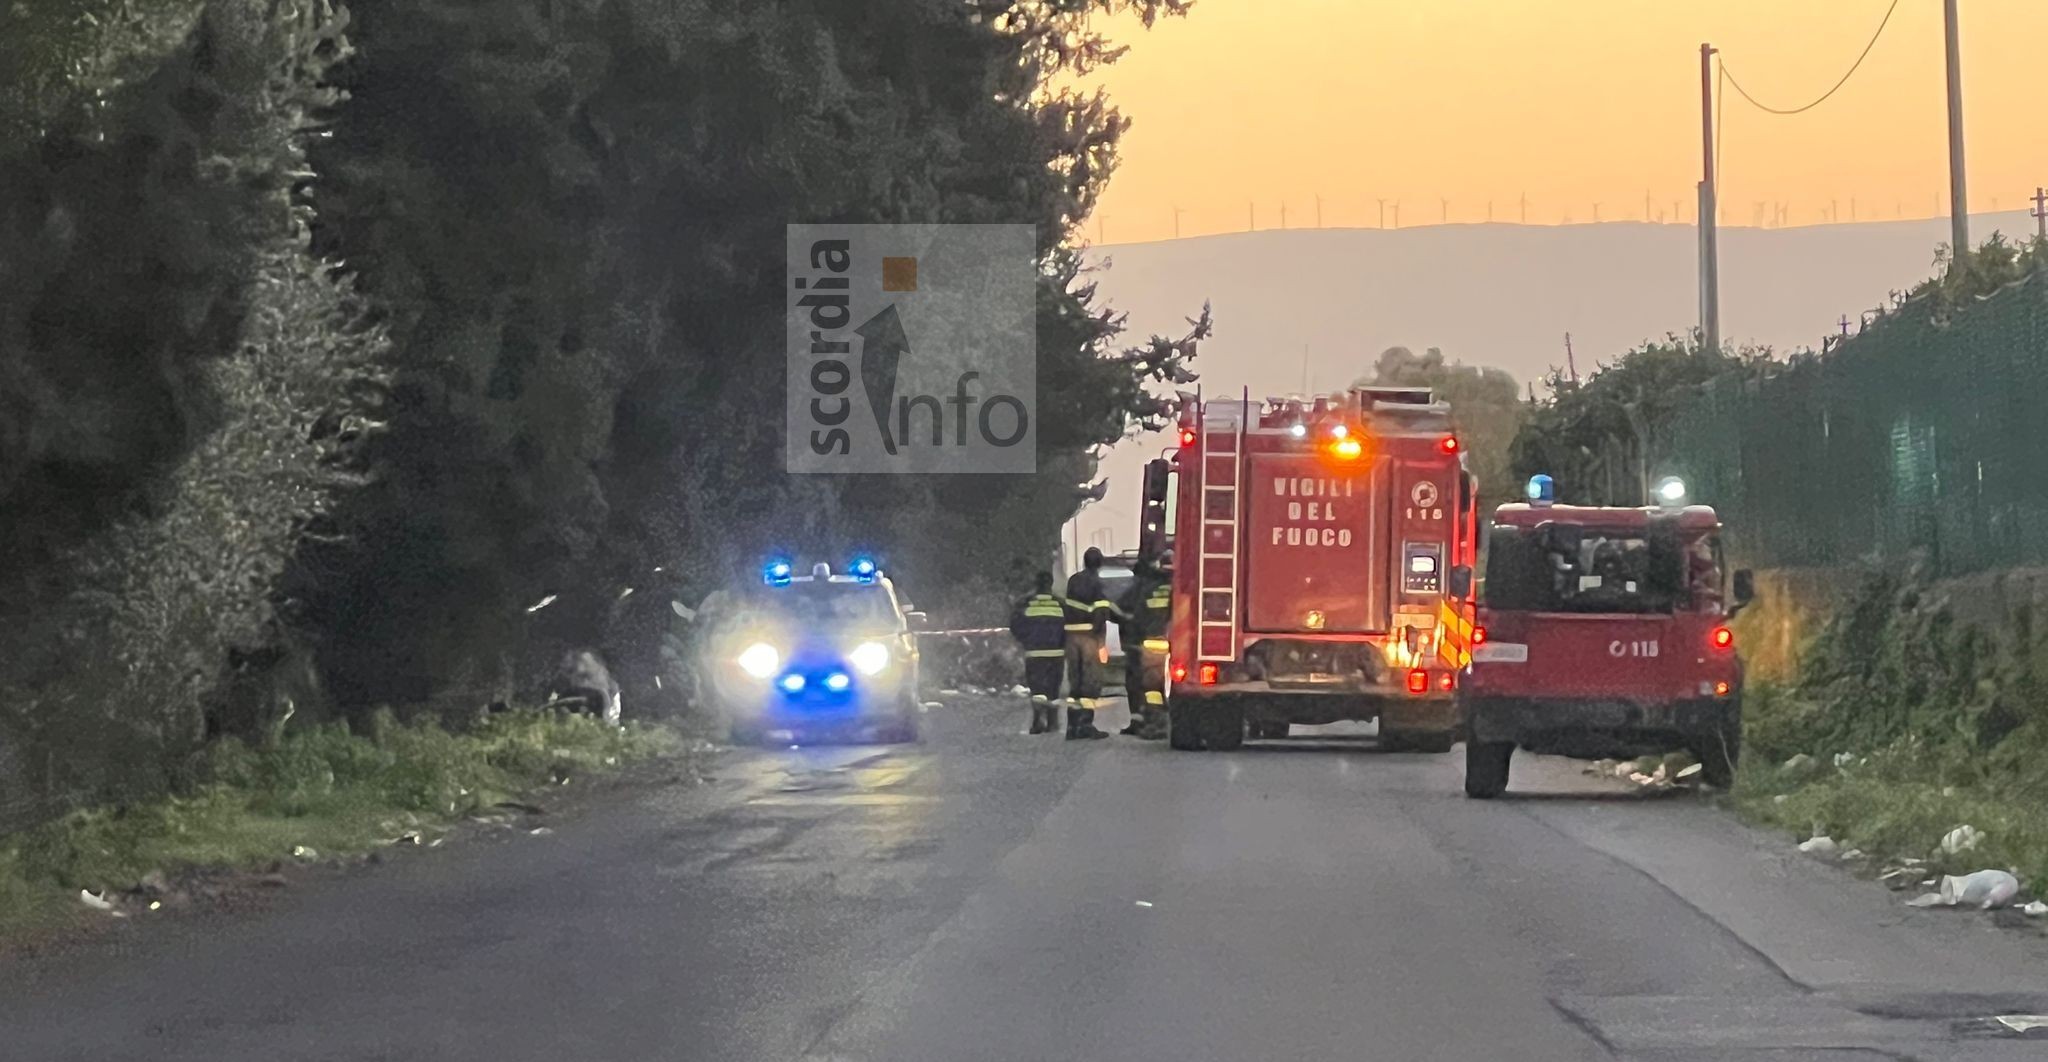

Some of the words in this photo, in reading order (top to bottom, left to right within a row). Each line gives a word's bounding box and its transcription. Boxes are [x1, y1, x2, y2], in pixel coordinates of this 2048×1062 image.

[1274, 478, 1352, 497] VIGILI
[1288, 502, 1336, 520] DEL
[1272, 527, 1352, 547] FUOCO
